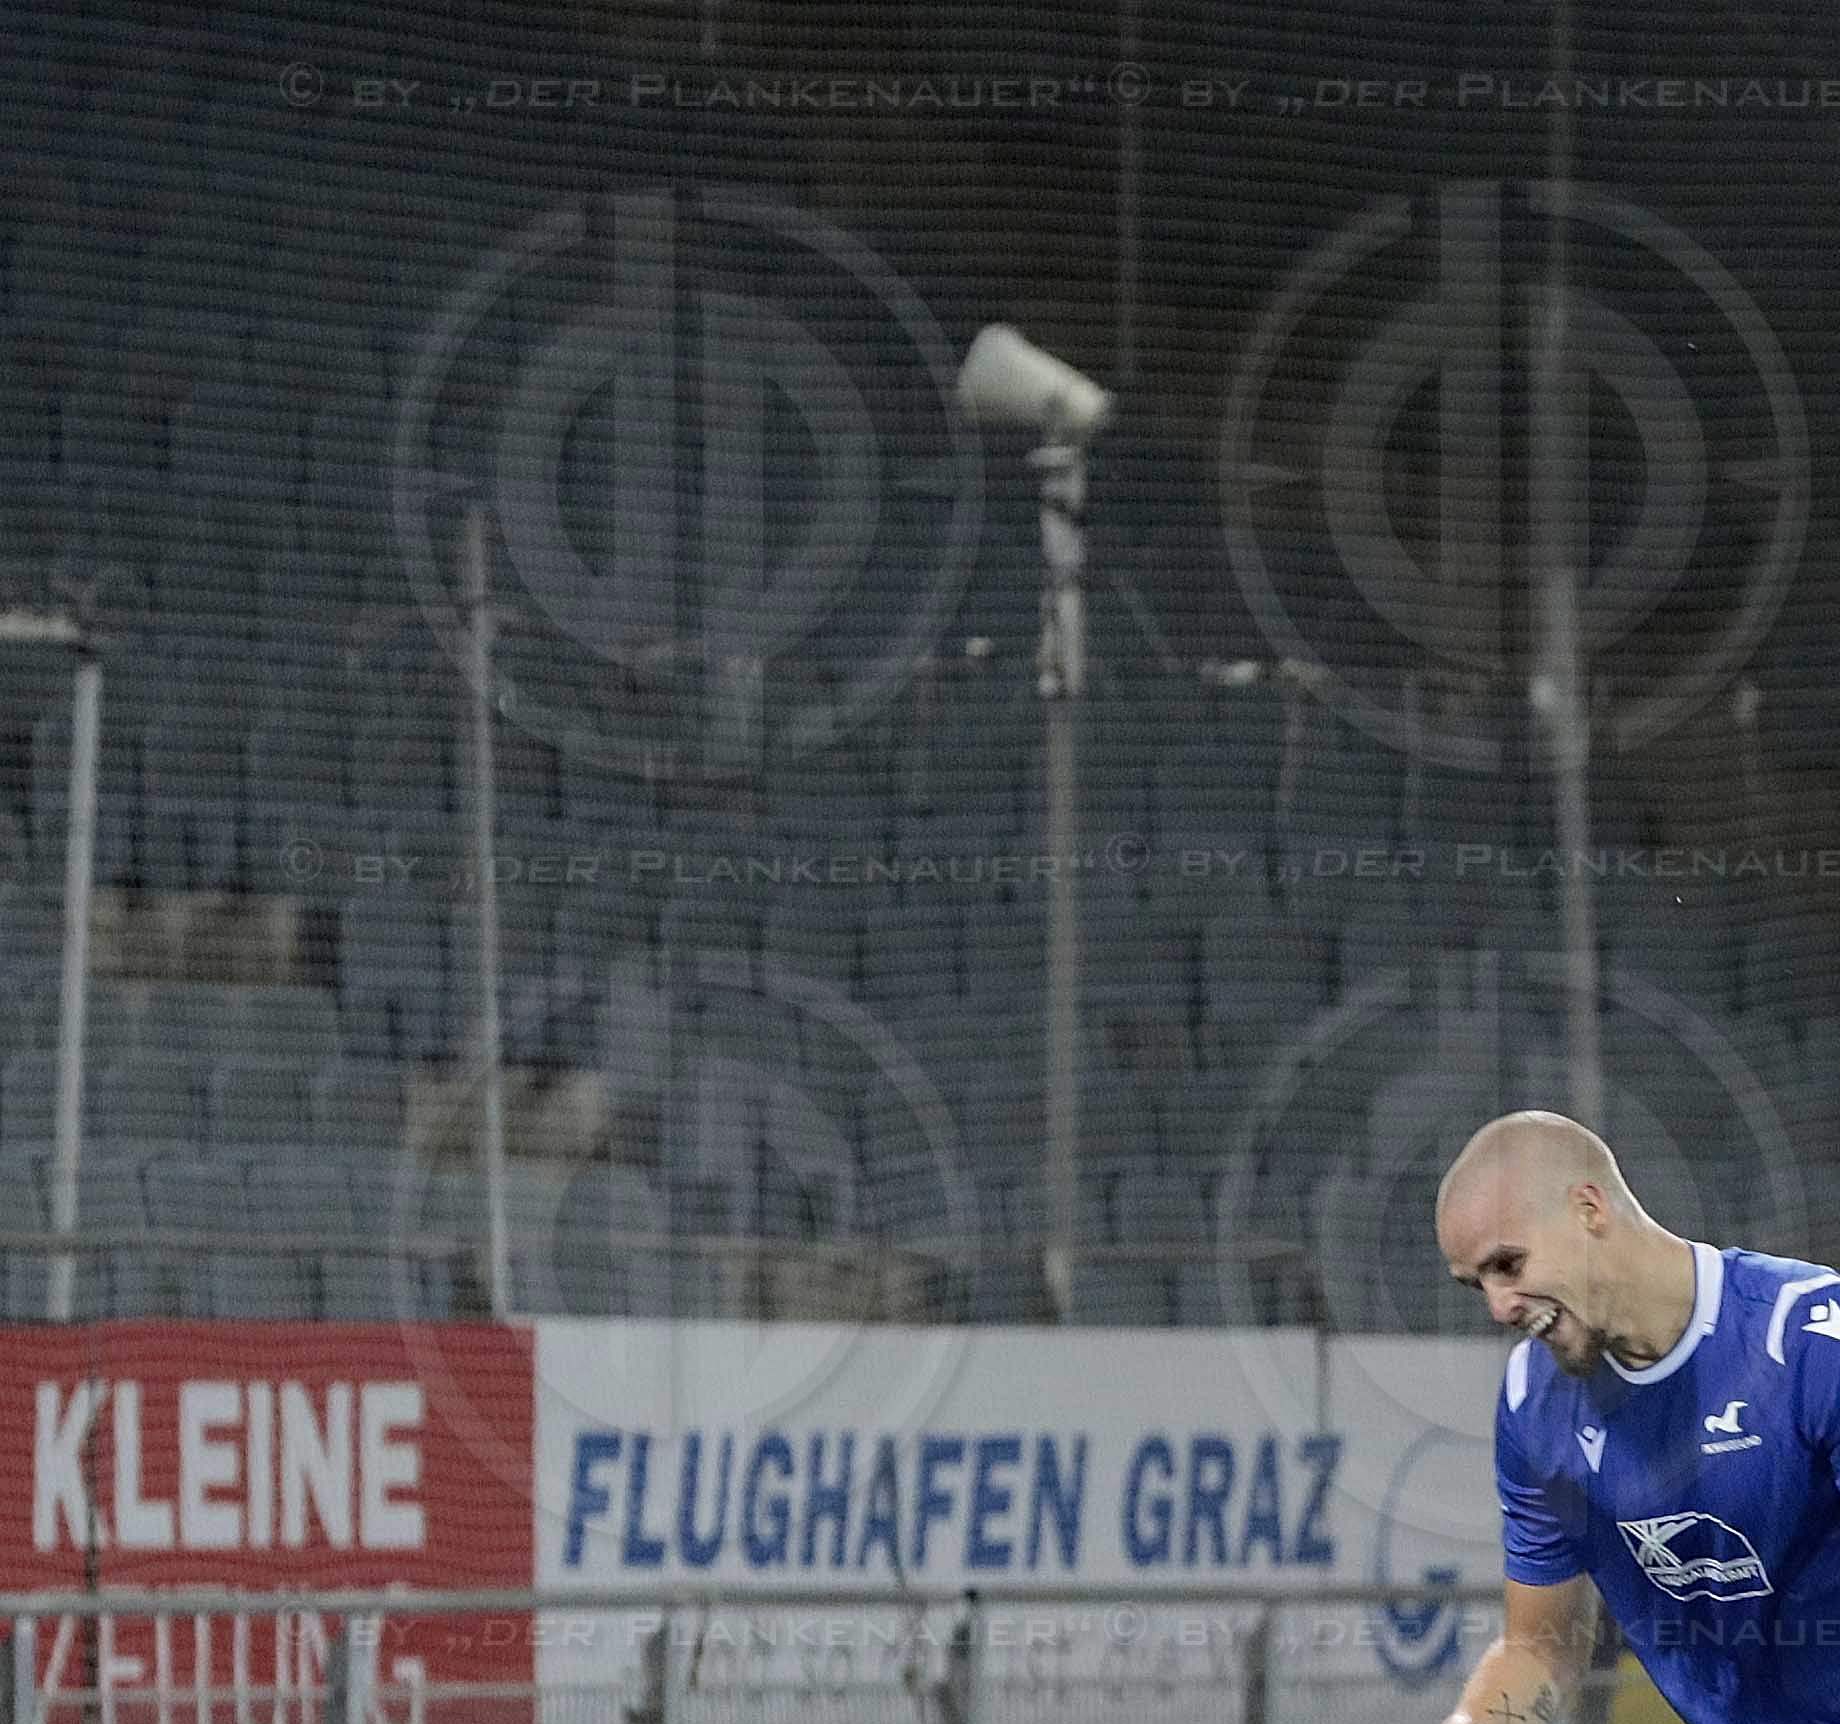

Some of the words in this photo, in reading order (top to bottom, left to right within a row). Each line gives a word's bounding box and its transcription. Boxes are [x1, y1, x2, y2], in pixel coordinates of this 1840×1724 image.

[33, 1378, 427, 1552] KLEINE
[561, 1431, 1089, 1569] FLUGHAFEN
[1122, 1432, 1341, 1568] GRAZ
